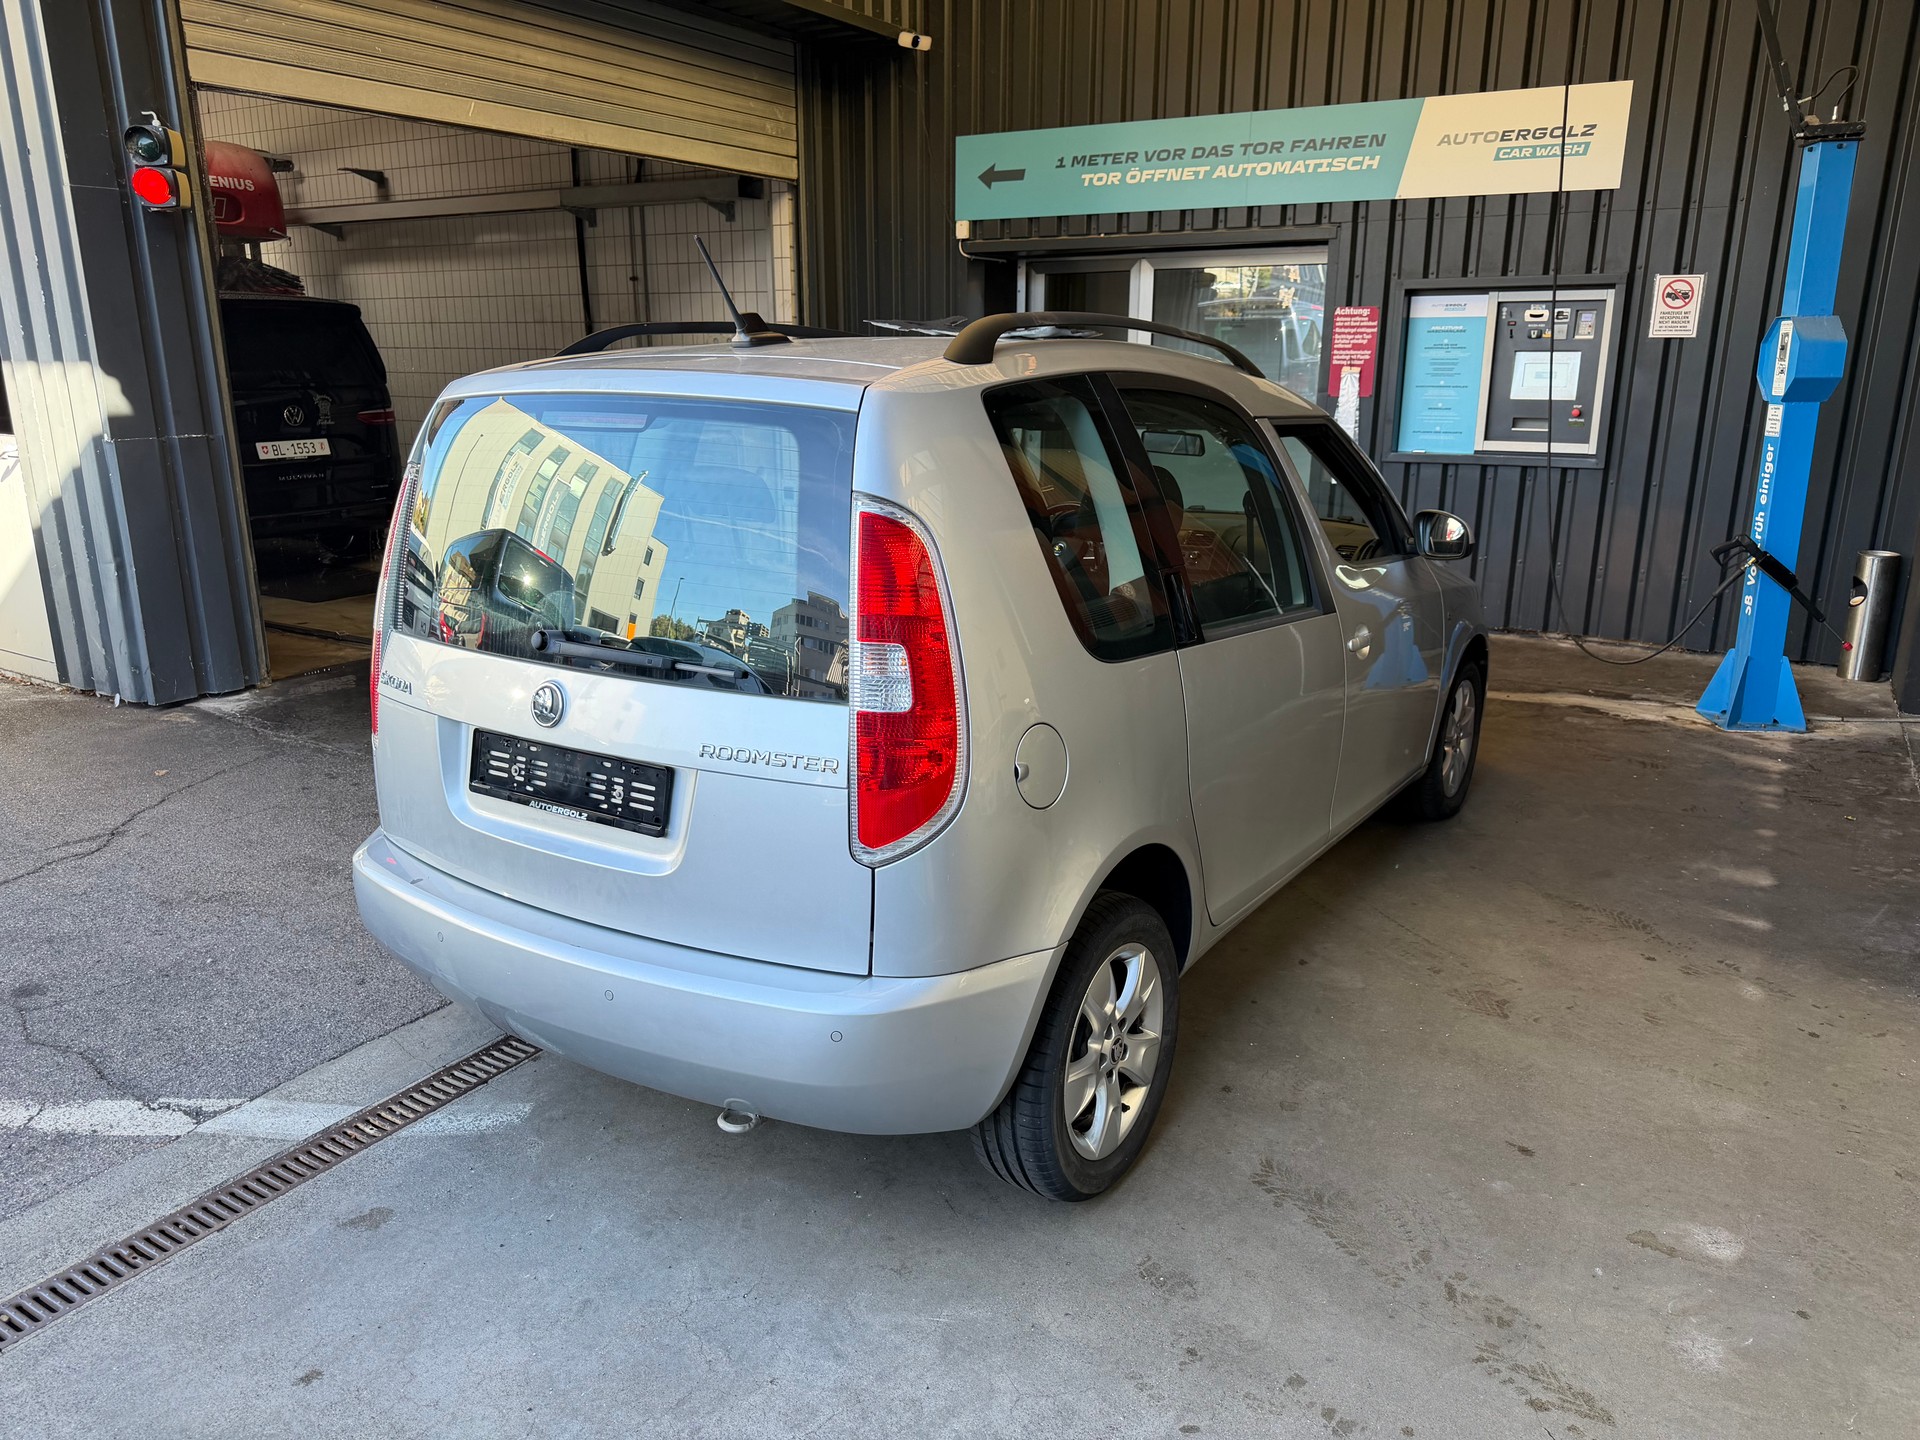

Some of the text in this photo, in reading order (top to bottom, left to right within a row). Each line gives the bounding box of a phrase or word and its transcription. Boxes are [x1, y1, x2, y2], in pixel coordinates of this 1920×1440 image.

[1437, 123, 1598, 147] AUTOERGOLZ
[1055, 133, 1386, 169] 1 METER VOR DAS TOR FAHREN
[1499, 144, 1585, 159] CAR WASH
[1081, 155, 1380, 187] TOR ÖFFNET AUTOMATISCH
[208, 175, 255, 192] ENIUS
[1334, 307, 1370, 316] Achtung:
[699, 742, 840, 774] ROOMSTER
[529, 799, 588, 821] AUTOERGOLZ
